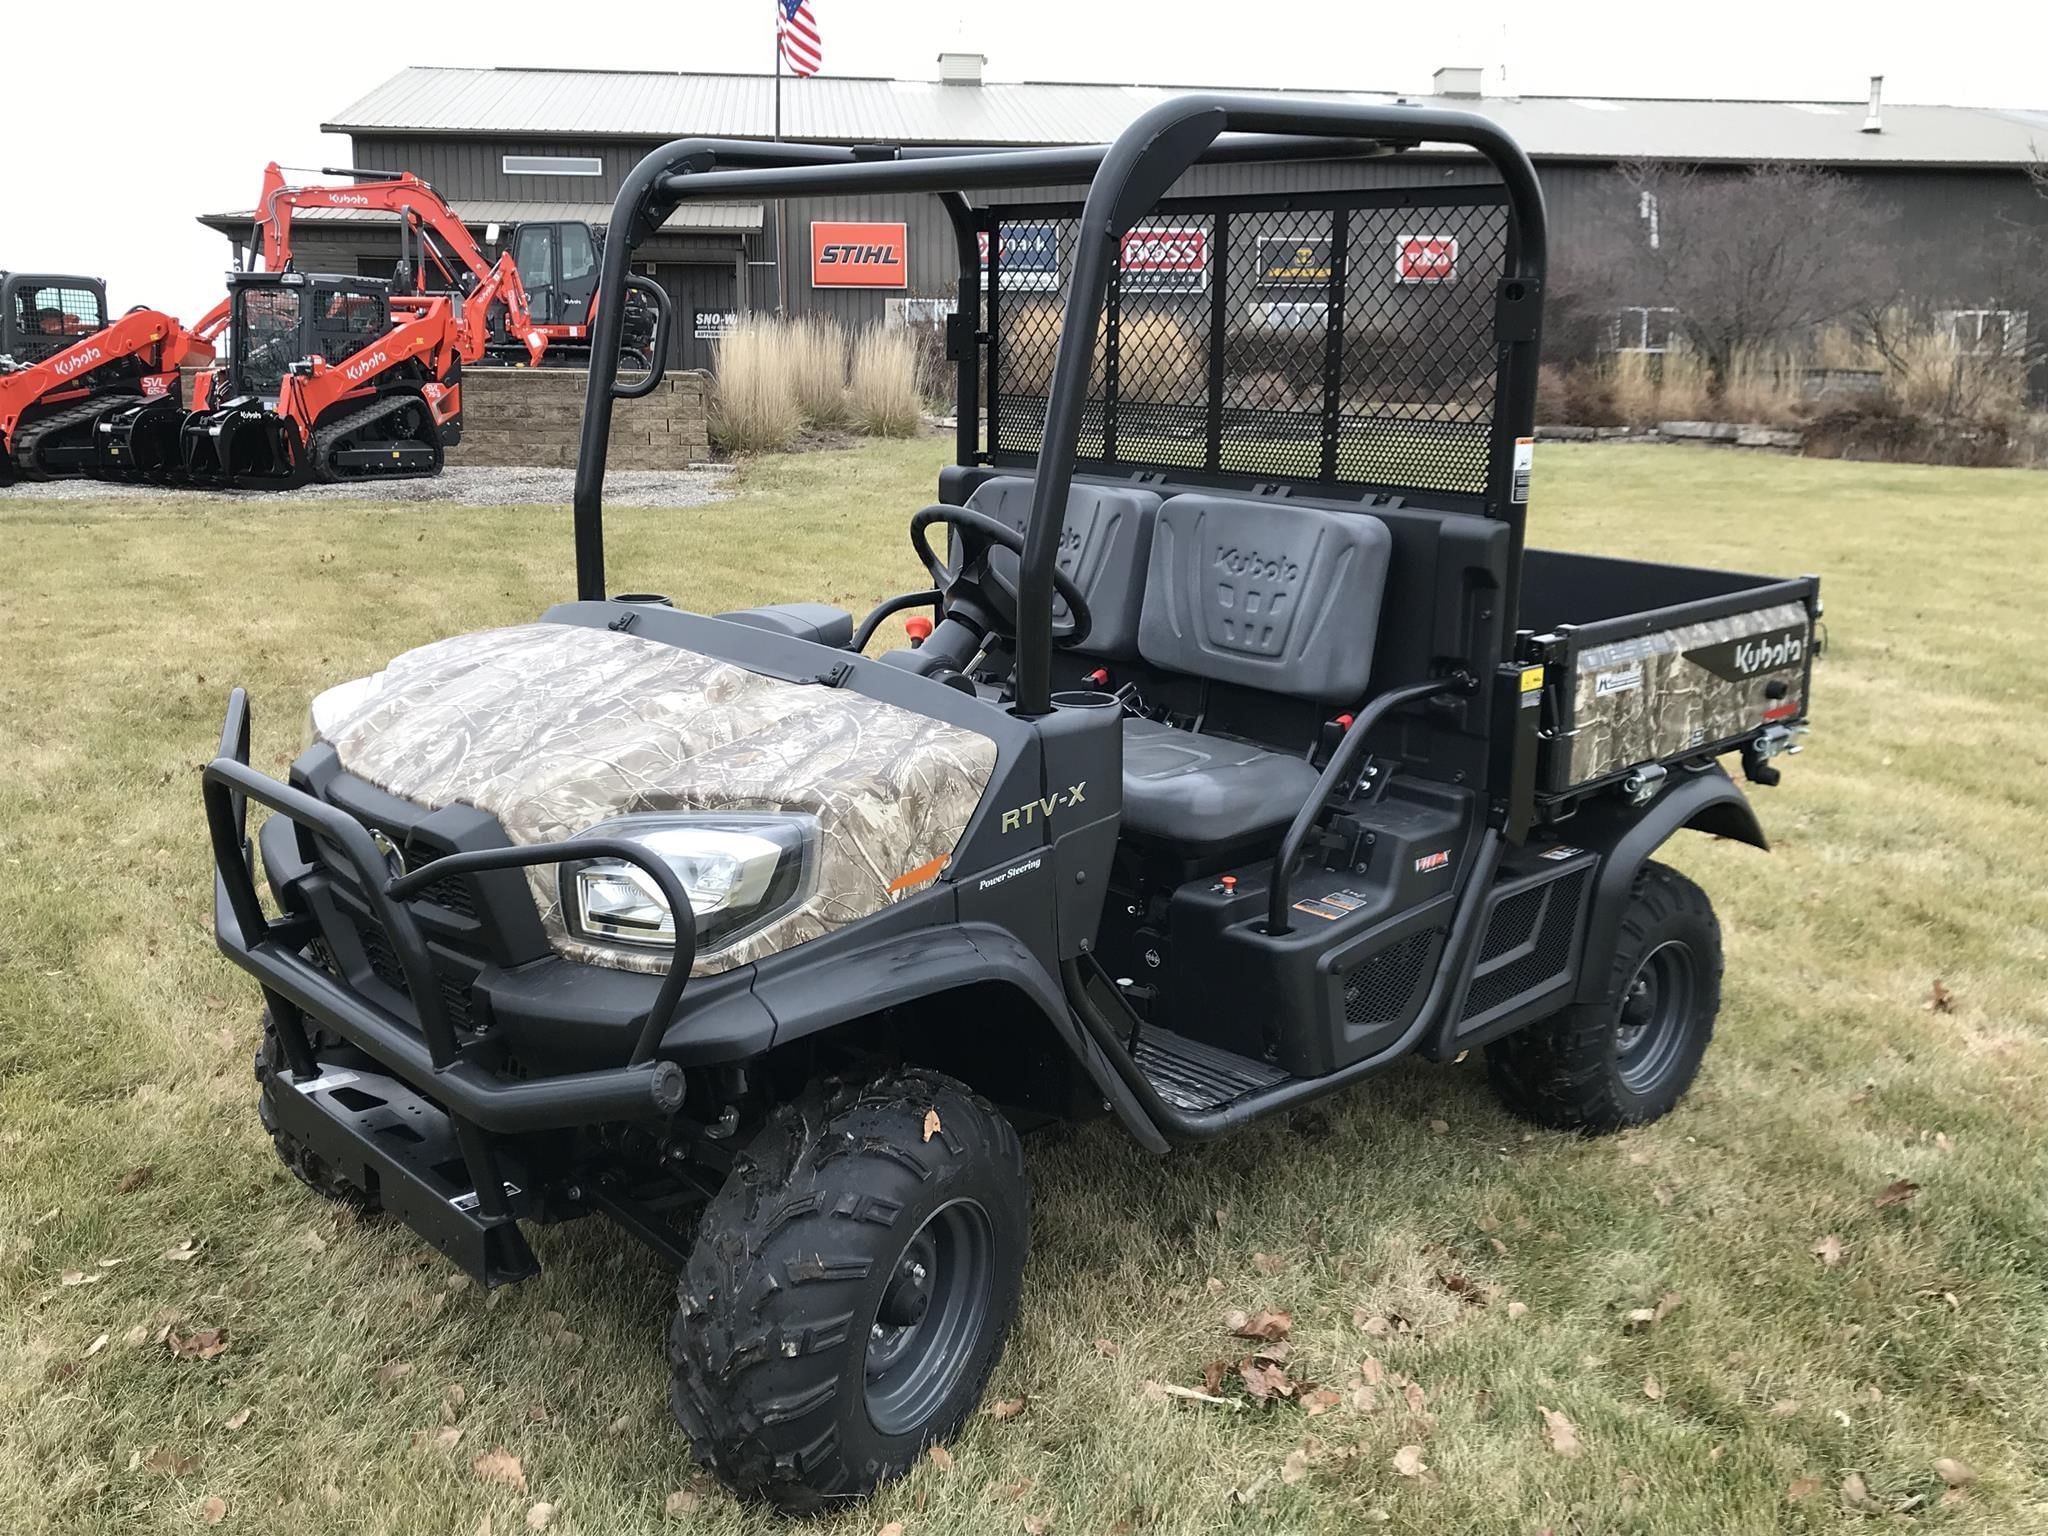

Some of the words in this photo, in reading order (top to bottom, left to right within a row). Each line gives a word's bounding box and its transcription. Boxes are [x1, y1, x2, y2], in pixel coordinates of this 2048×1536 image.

[328, 193, 368, 205] Kubota
[819, 244, 900, 264] STIHL
[54, 347, 102, 375] Kubota
[346, 351, 387, 380] Kubota
[142, 377, 167, 387] SVL
[1214, 546, 1298, 582] Kubota
[1734, 633, 1801, 674] Kubota
[1001, 781, 1087, 834] RTV-X
[979, 872, 1007, 891] Power
[1006, 858, 1041, 879] Steering
